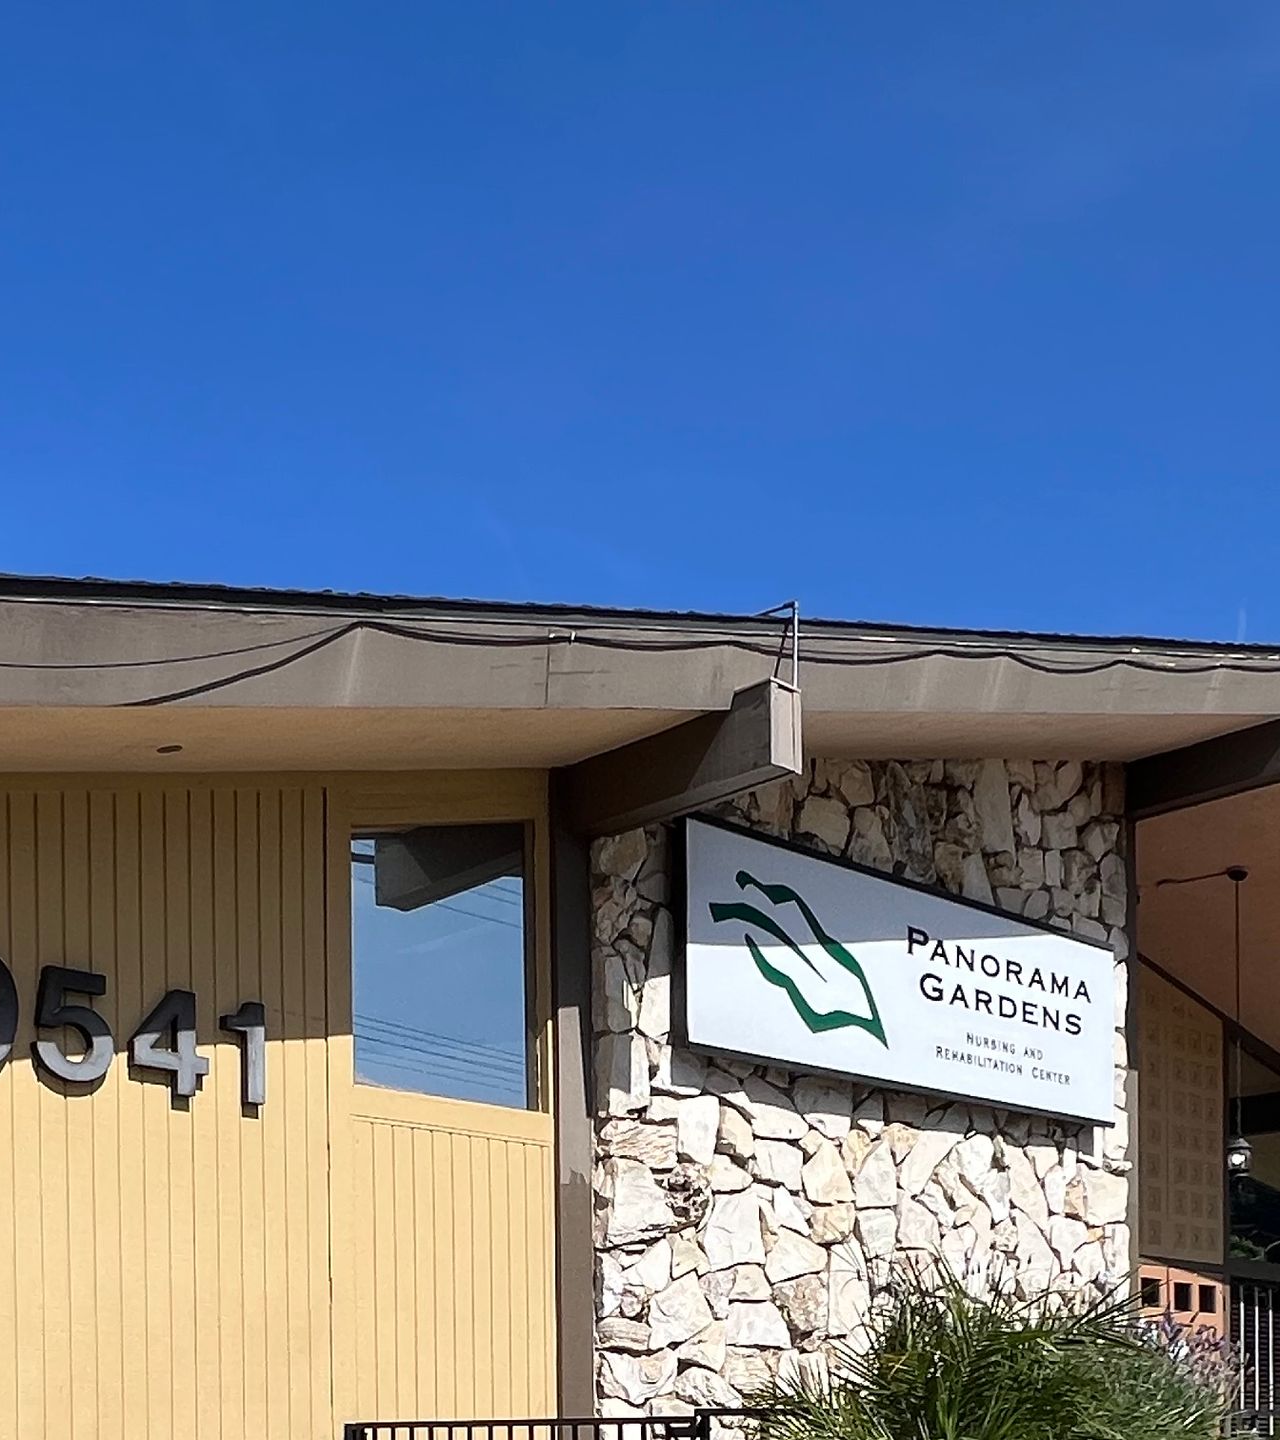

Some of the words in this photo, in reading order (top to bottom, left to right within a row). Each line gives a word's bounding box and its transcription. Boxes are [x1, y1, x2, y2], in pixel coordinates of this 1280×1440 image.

[907, 925, 1092, 1003] PANORAMA
[920, 973, 1082, 1036] GARDENS
[935, 1045, 1023, 1076] REHABILITATION
[1031, 1066, 1071, 1086] CENTER
[966, 1032, 1016, 1055] NURSING
[1023, 1046, 1044, 1061] AND
